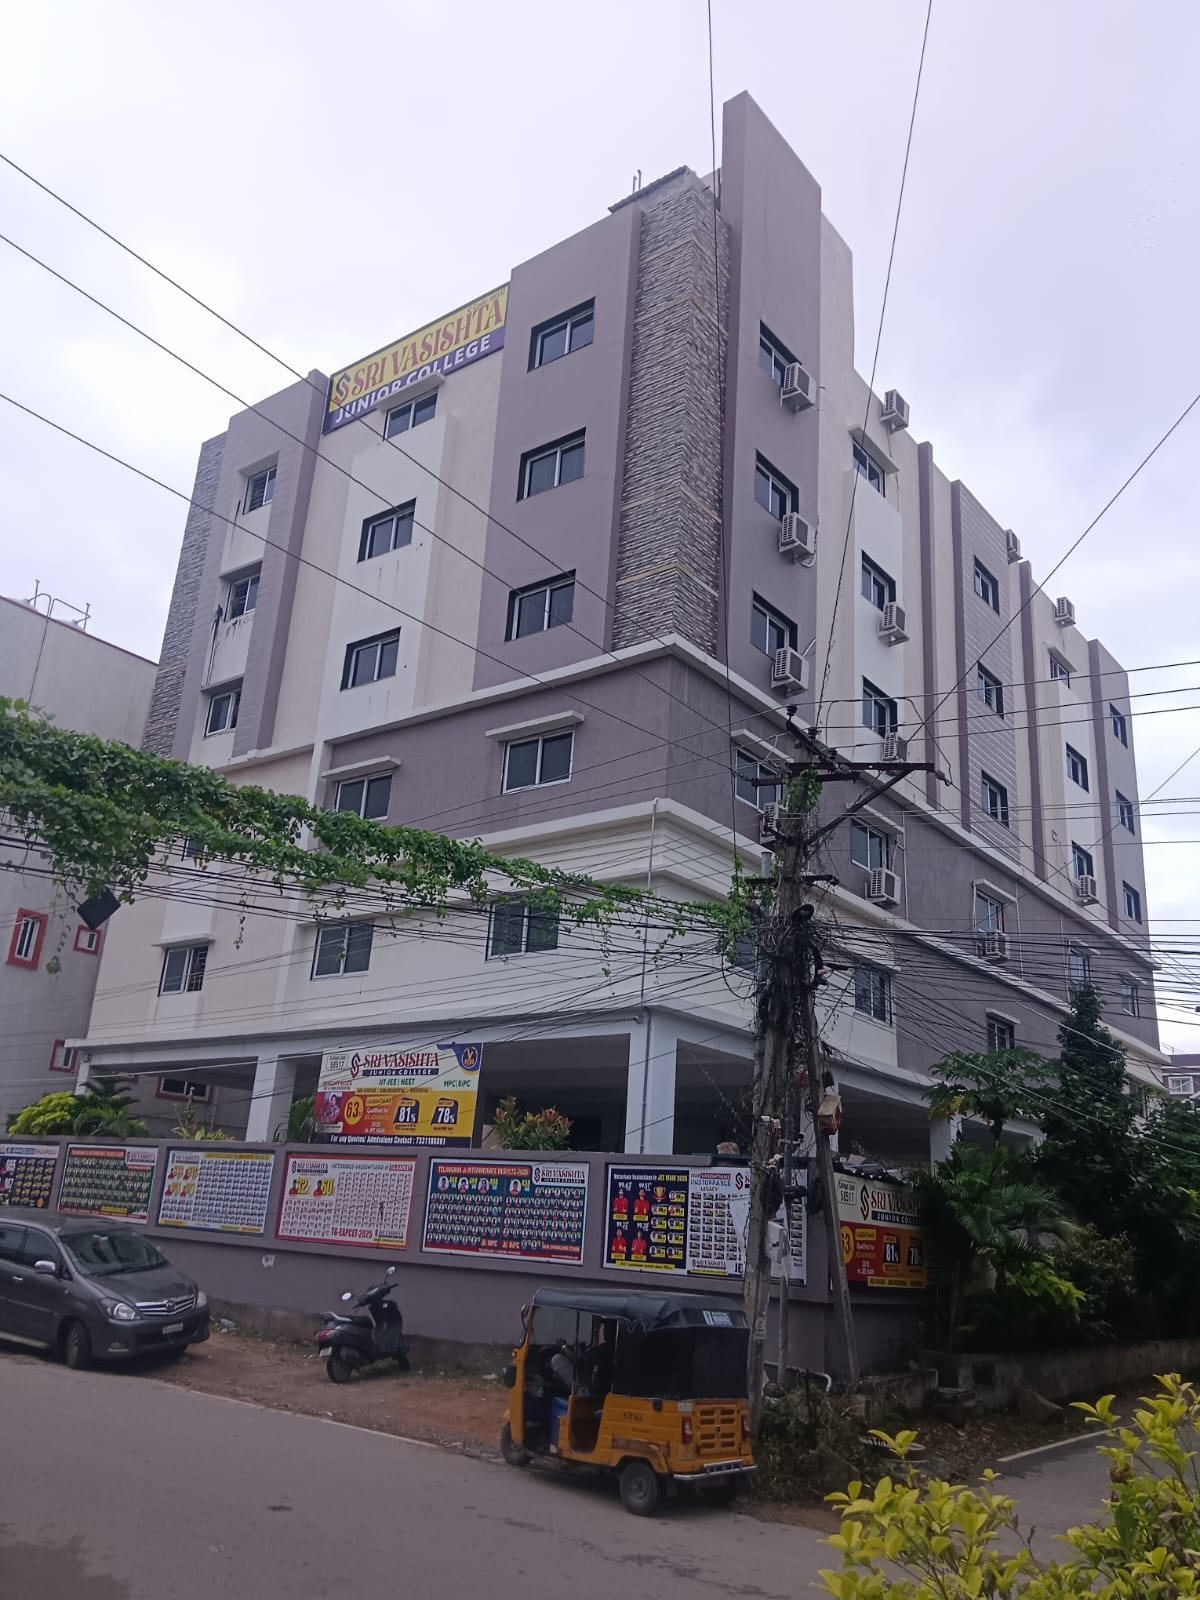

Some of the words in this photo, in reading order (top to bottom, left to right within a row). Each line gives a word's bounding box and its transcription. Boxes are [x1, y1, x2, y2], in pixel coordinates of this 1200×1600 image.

[351, 357, 387, 396] SRI
[391, 299, 503, 377] VASISHTA
[335, 379, 401, 423] JUNIOR
[406, 334, 490, 386] COLLEGE
[364, 1054, 381, 1068] SRI
[383, 1053, 439, 1068] VASISHTA
[401, 1078, 415, 1086] NEET
[871, 1190, 886, 1210] SRI
[877, 1212, 900, 1223] JUNIOR
